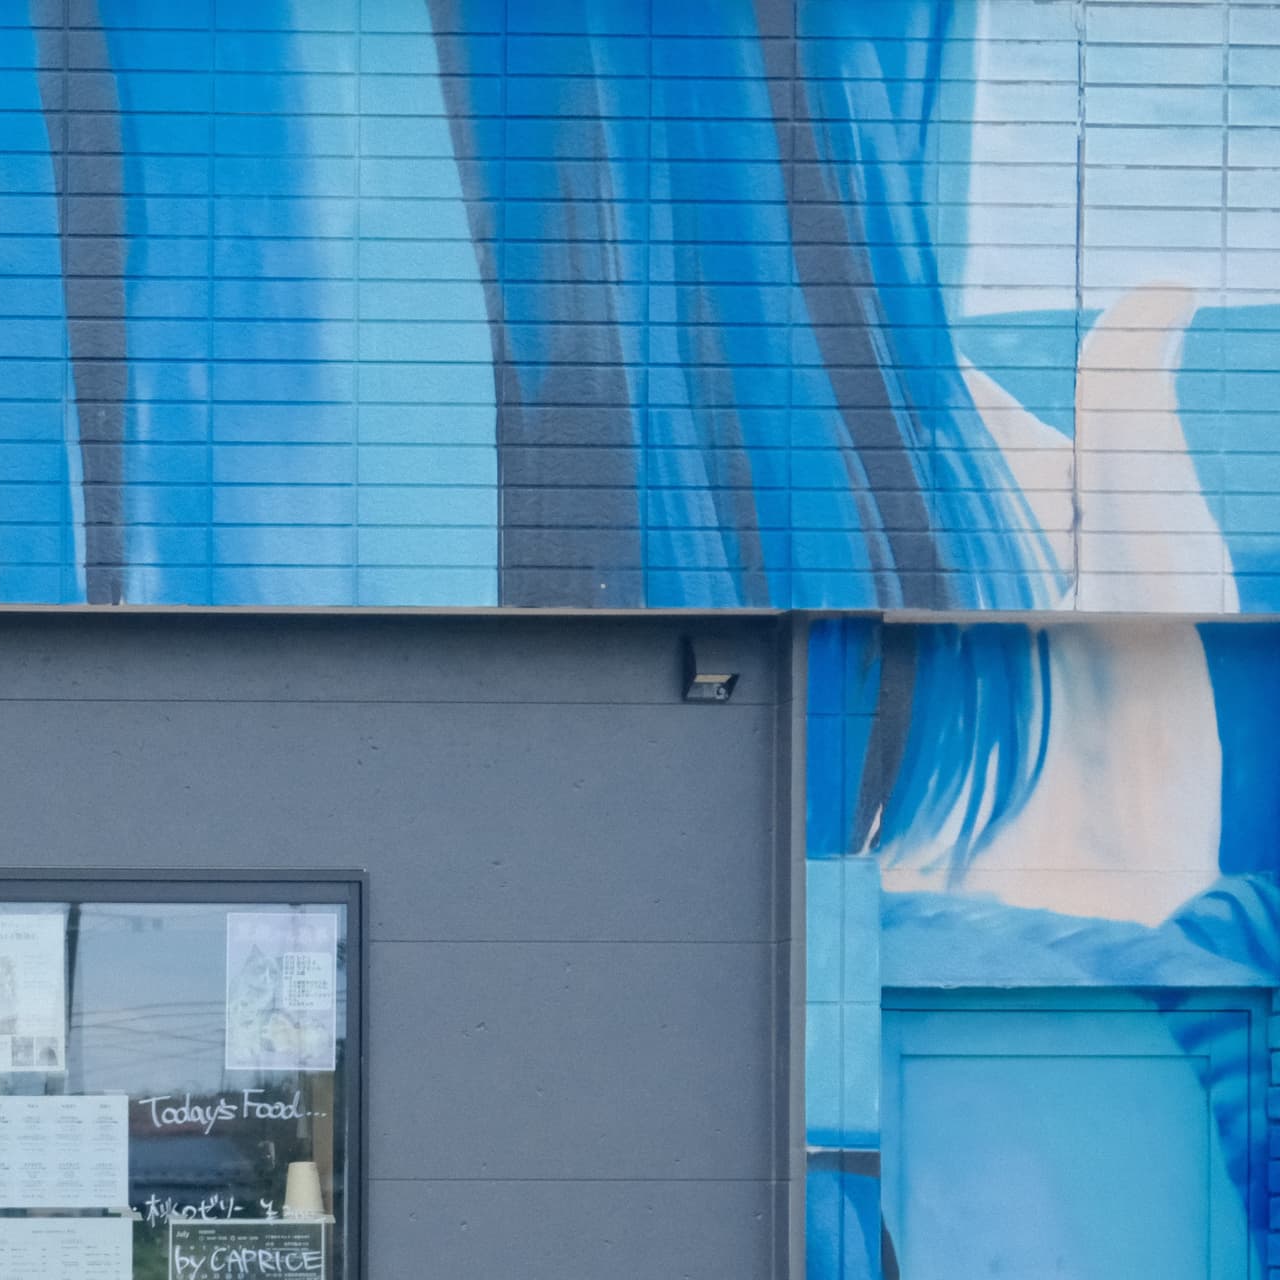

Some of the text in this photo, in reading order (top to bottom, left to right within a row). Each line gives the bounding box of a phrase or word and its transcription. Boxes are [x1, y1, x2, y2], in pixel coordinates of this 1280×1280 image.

[138, 1092, 239, 1135] Today's
[175, 1230, 190, 1239] July
[210, 1247, 324, 1274] CAPRICE
